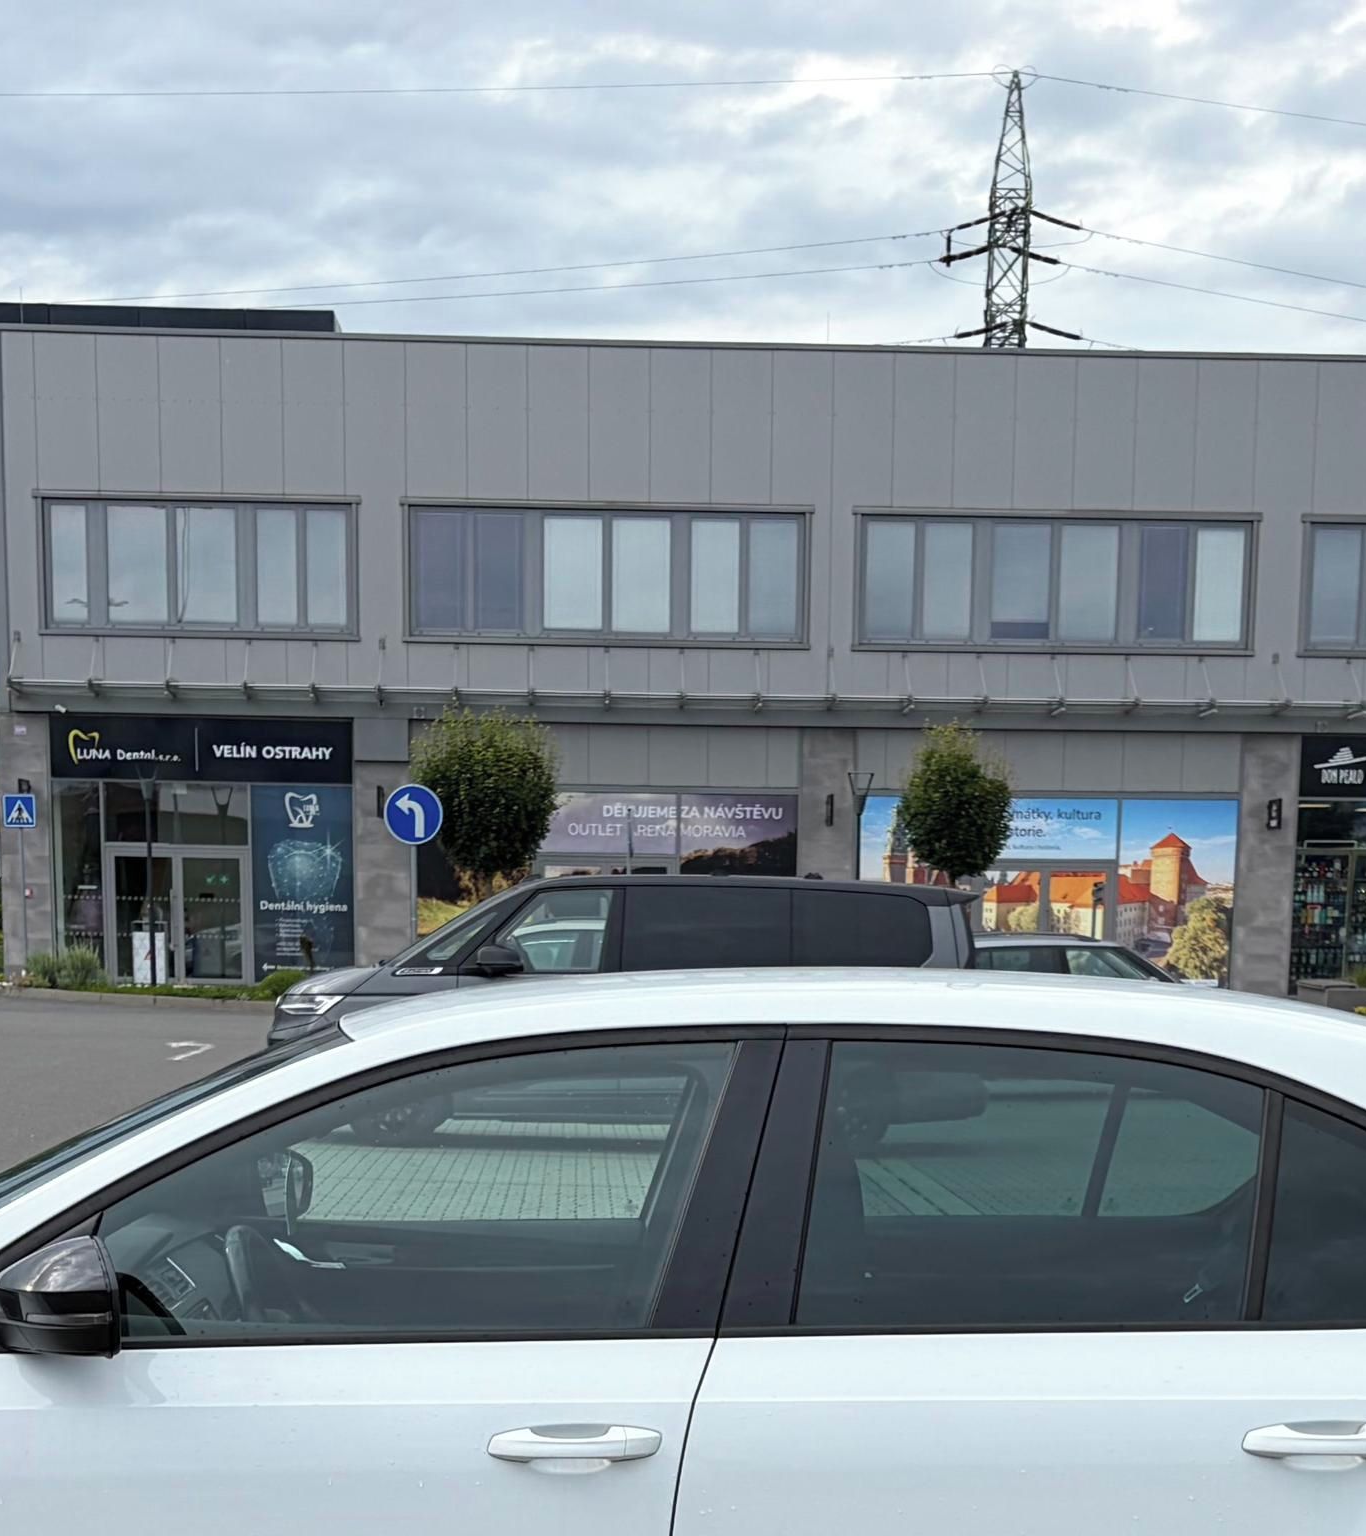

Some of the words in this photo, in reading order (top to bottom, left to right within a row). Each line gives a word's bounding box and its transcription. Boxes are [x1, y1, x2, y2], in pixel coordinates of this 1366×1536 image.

[77, 748, 111, 760] LUNA
[212, 743, 257, 758] VELÍN
[262, 746, 333, 760] OSTRAHY
[681, 805, 699, 819] ZA
[703, 804, 783, 820] NÁVŠTĚVU
[1057, 808, 1102, 820] kultura
[568, 823, 623, 836] OUTLET
[633, 823, 676, 837] RENA
[679, 825, 747, 838] MORAVIA
[260, 900, 304, 912] Dentální
[306, 901, 348, 914] hygiena
